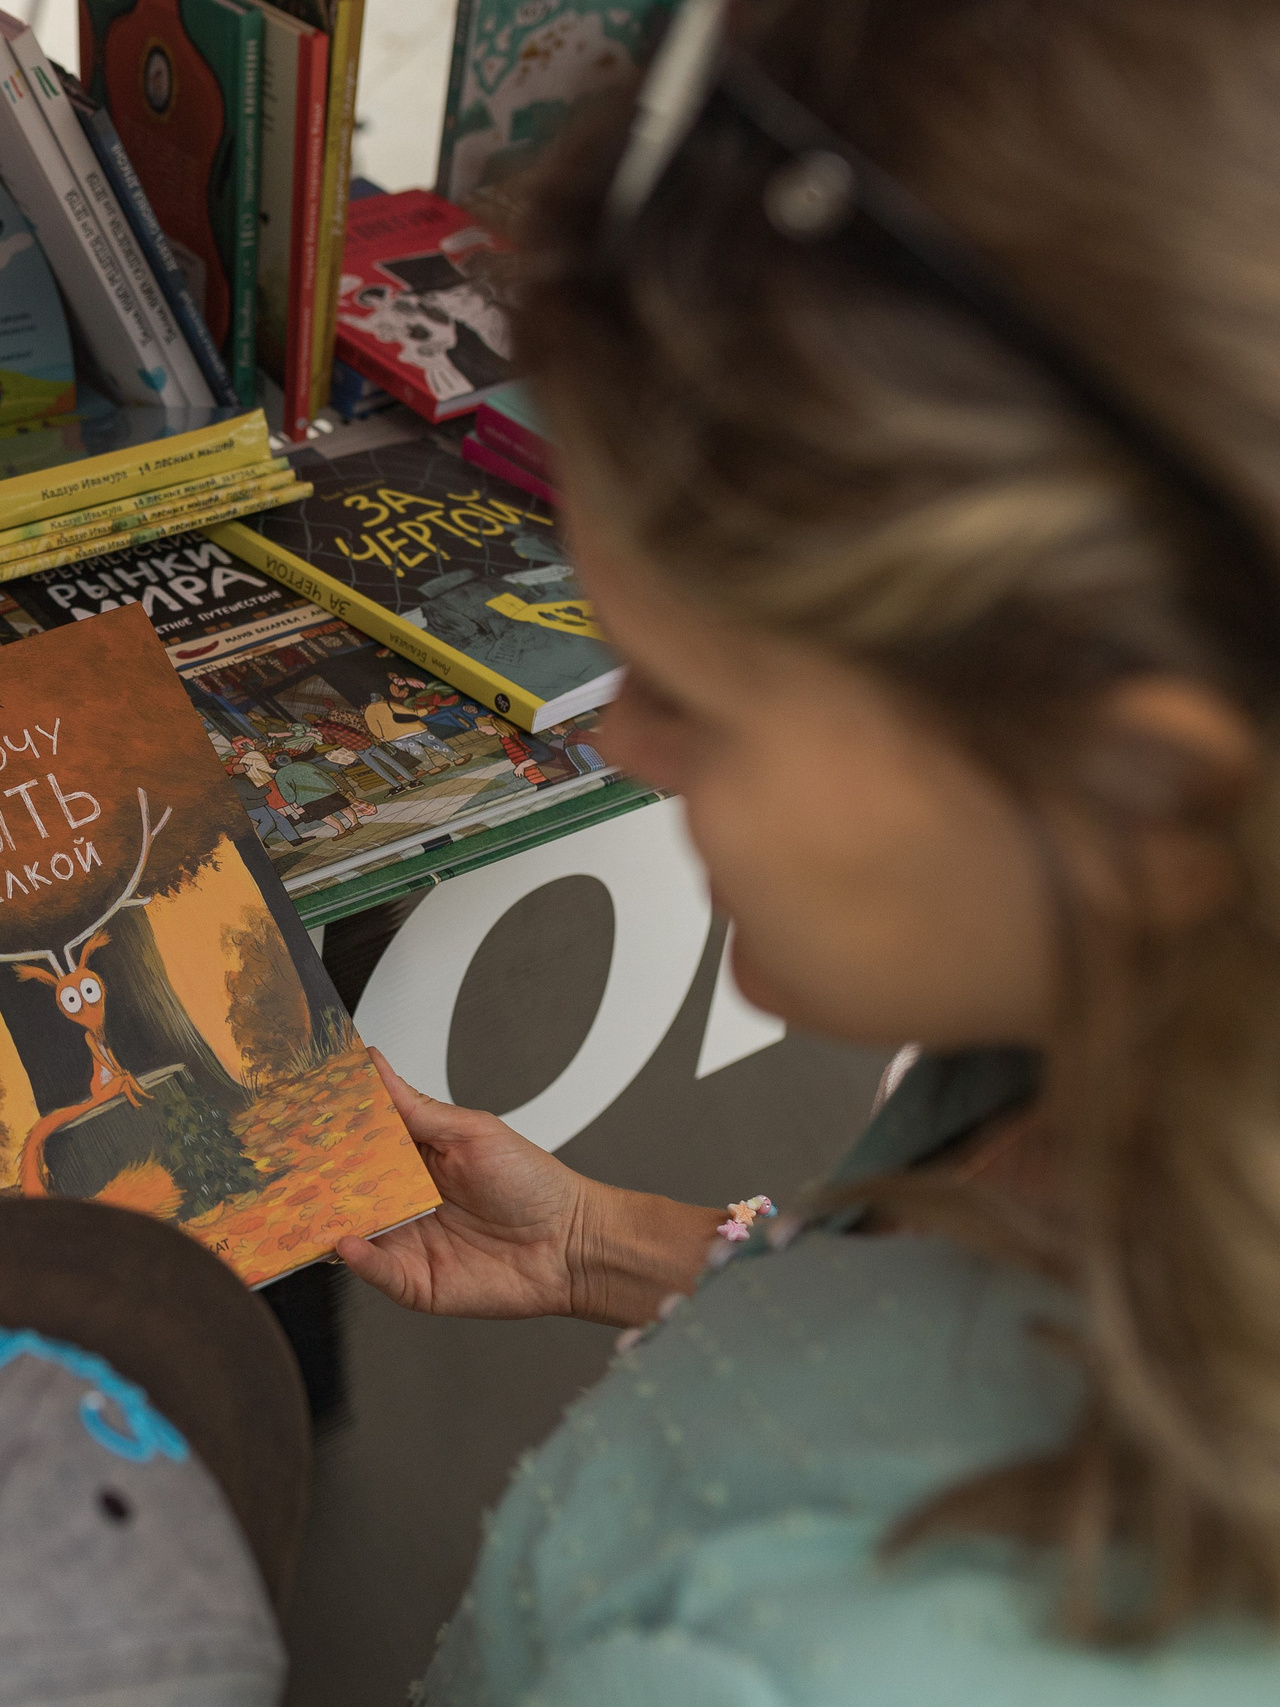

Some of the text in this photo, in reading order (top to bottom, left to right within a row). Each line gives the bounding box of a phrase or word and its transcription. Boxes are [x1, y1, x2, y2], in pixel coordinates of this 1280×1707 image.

[334, 489, 554, 578] ЧЕРТОЙ
[342, 488, 445, 528] ЗА
[46, 543, 233, 608] РЫНКИ
[156, 590, 282, 634] ЕТНОЕ ПУТЕШЕСТВИЕ
